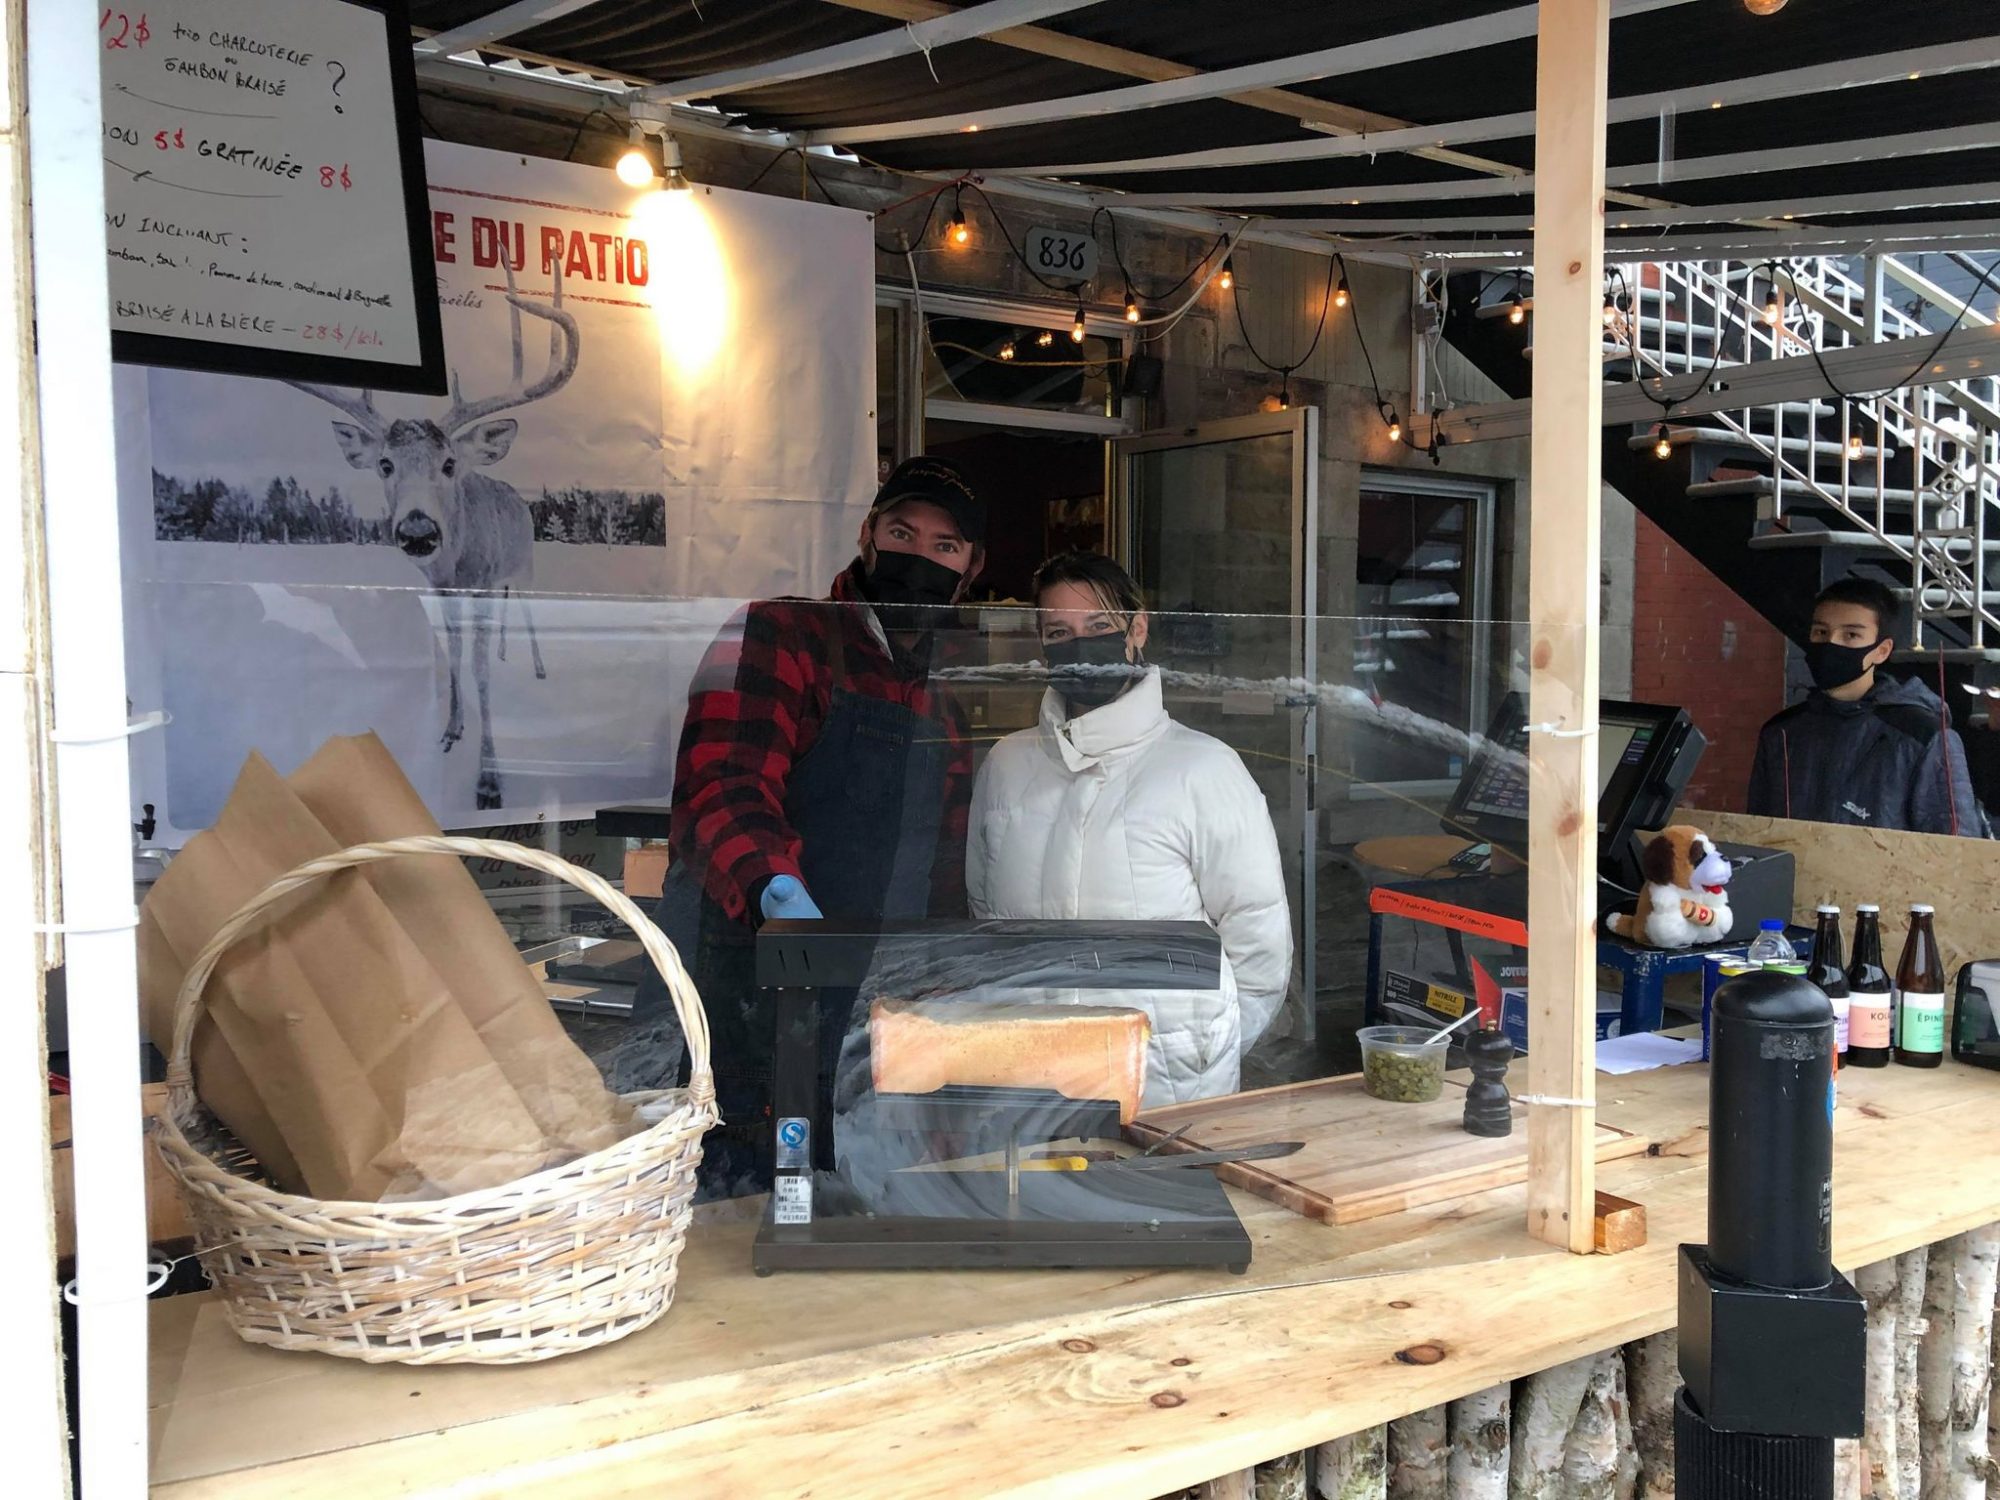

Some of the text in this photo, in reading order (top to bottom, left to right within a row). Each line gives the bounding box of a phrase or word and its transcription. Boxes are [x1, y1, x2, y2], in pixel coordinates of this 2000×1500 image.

[209, 32, 313, 66] CHARCUTERIE
[235, 71, 287, 97] BRAISÉ
[197, 140, 302, 179] GRATINÉE
[320, 164, 352, 190] 8$
[472, 216, 525, 271] DU
[540, 226, 649, 286] PATIO
[1039, 236, 1086, 271] 836
